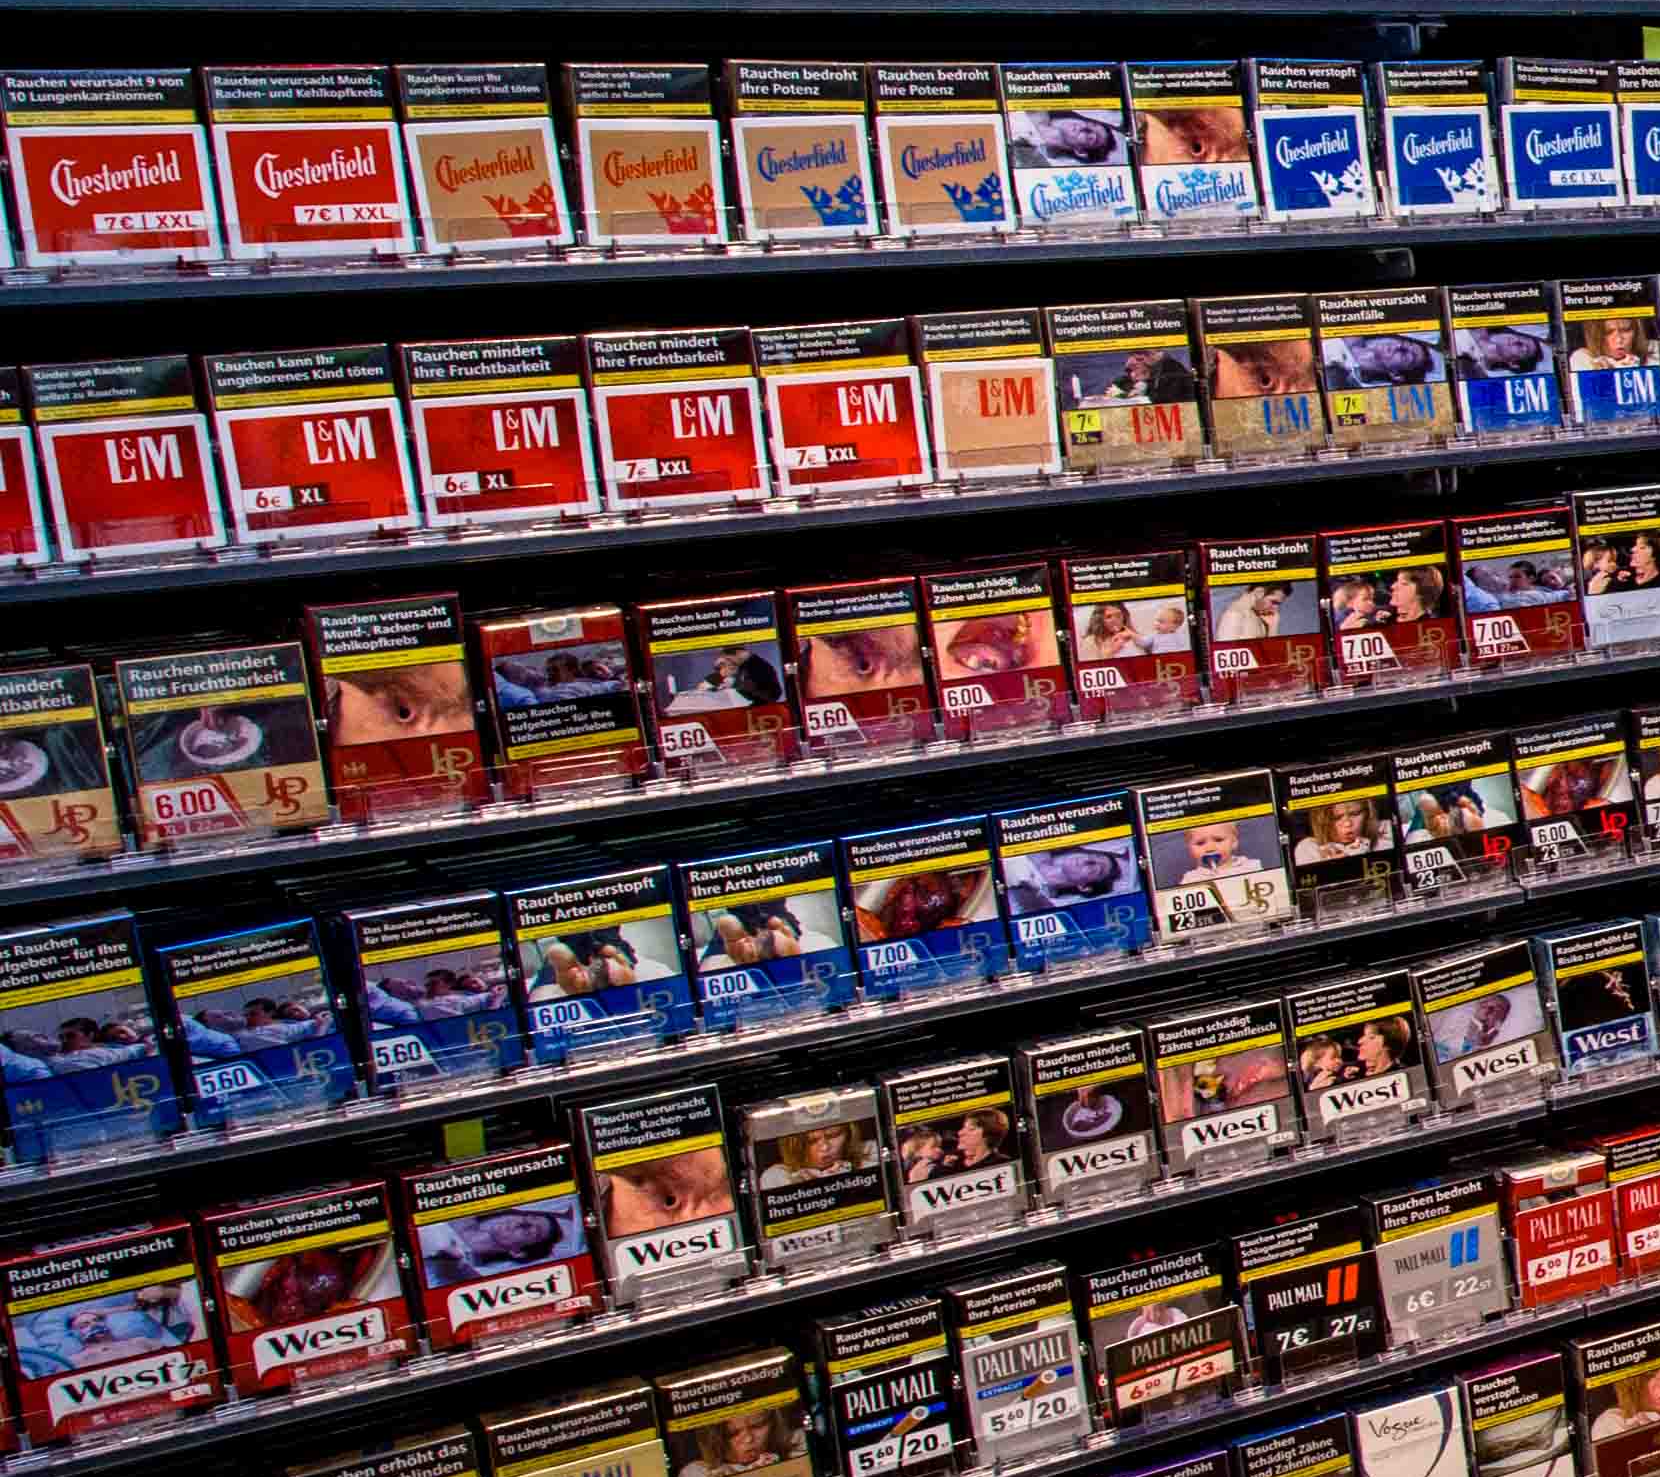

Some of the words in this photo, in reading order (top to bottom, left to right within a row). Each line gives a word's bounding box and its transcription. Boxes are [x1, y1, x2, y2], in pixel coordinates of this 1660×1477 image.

[49, 148, 183, 209] Chesterfield
[756, 139, 848, 184] Chesterfield
[304, 414, 376, 467] L&M
[300, 486, 327, 507] XL
[154, 784, 220, 822] 6.00
[456, 1276, 561, 1312] West
[263, 1322, 370, 1359] West
[974, 1348, 1016, 1383] PALL
[1018, 1334, 1070, 1372] MALL
